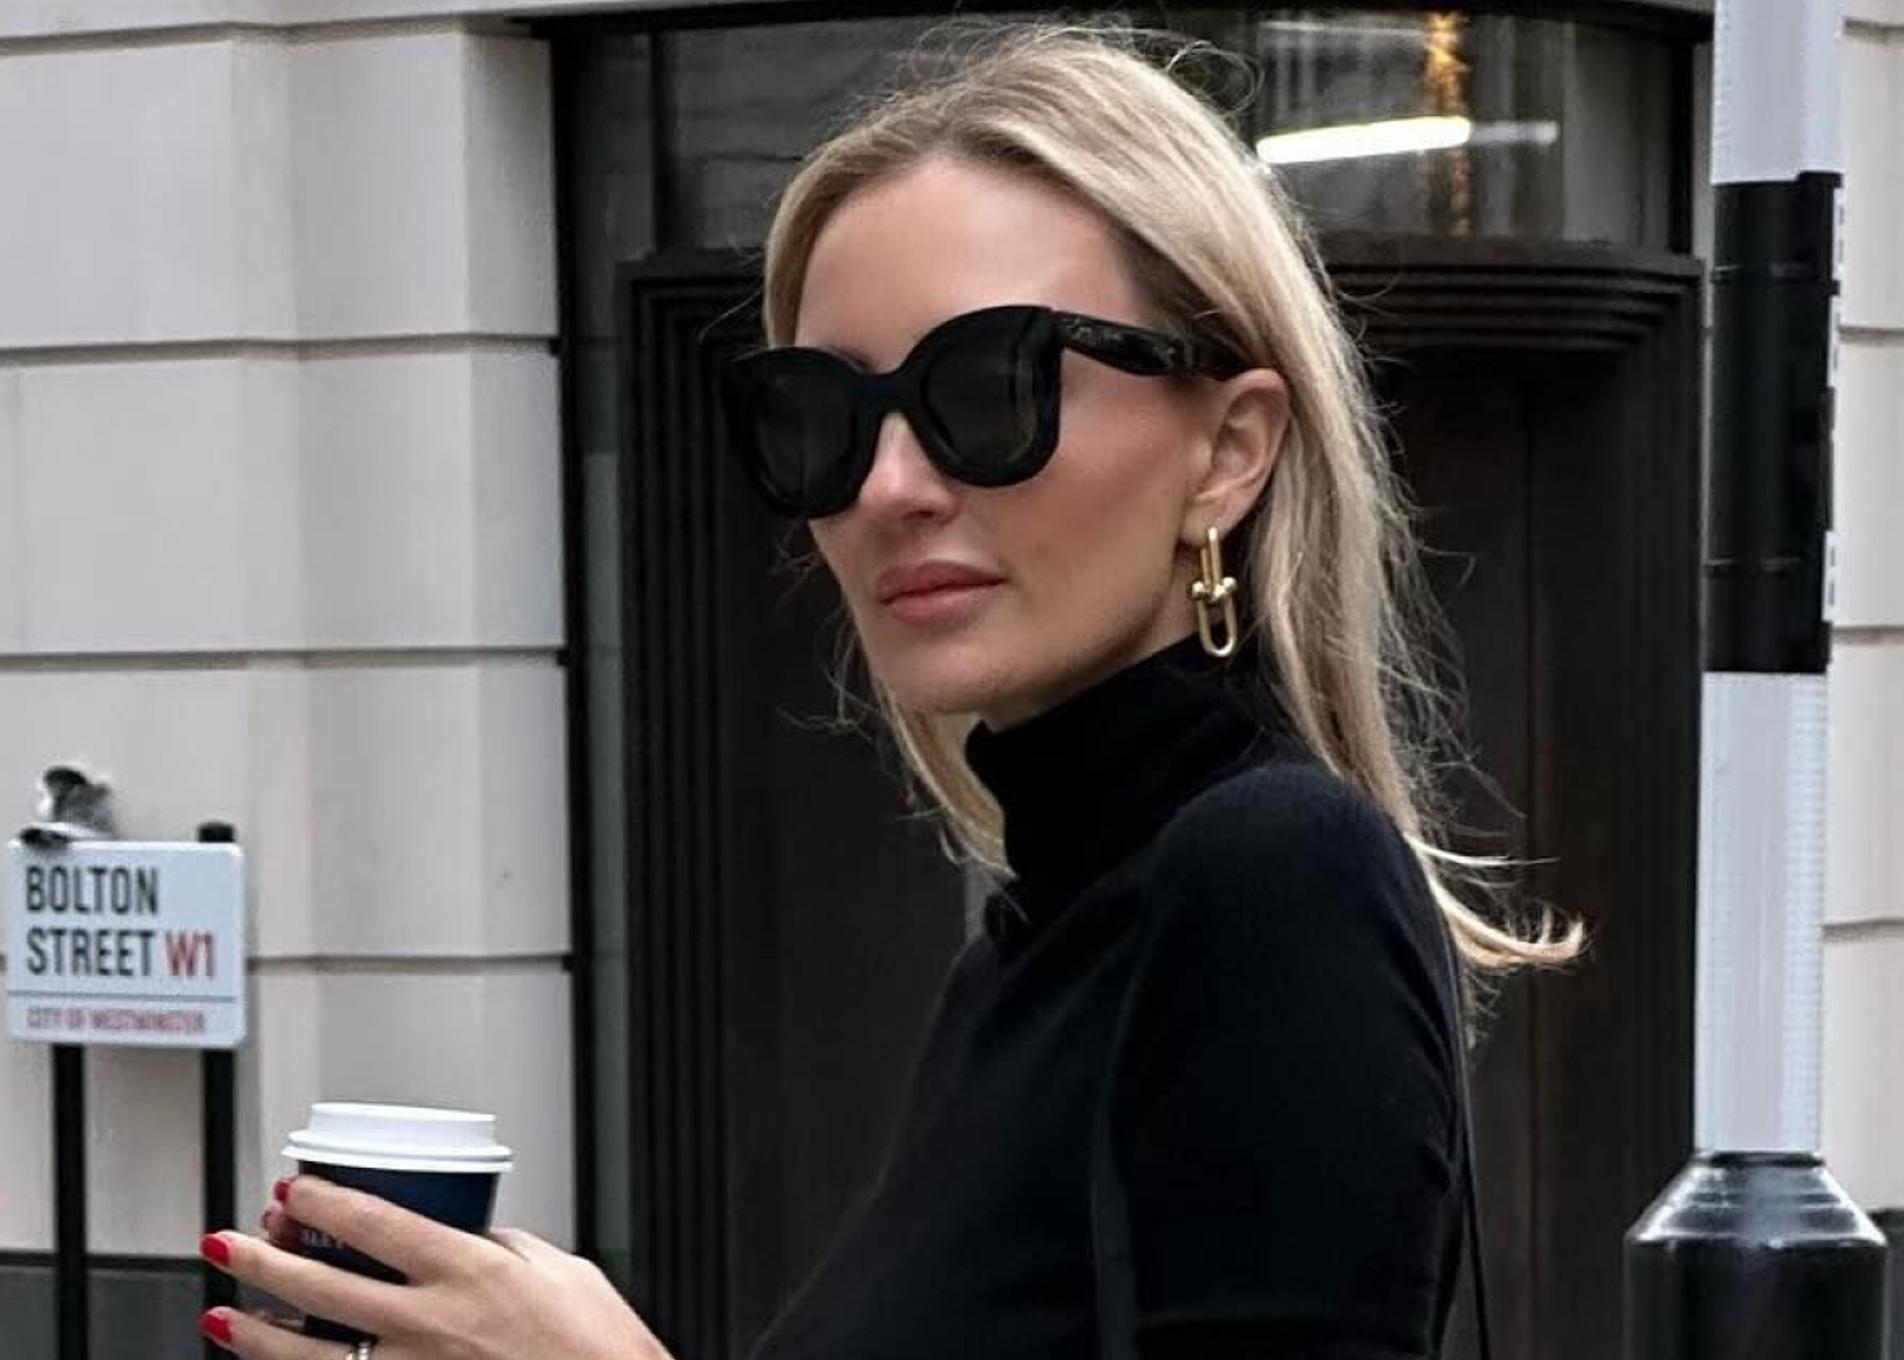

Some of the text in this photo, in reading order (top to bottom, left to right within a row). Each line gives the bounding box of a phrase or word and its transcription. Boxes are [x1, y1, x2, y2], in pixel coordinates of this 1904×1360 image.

[26, 865, 158, 915] BOLTON
[26, 926, 214, 978] STREET W1
